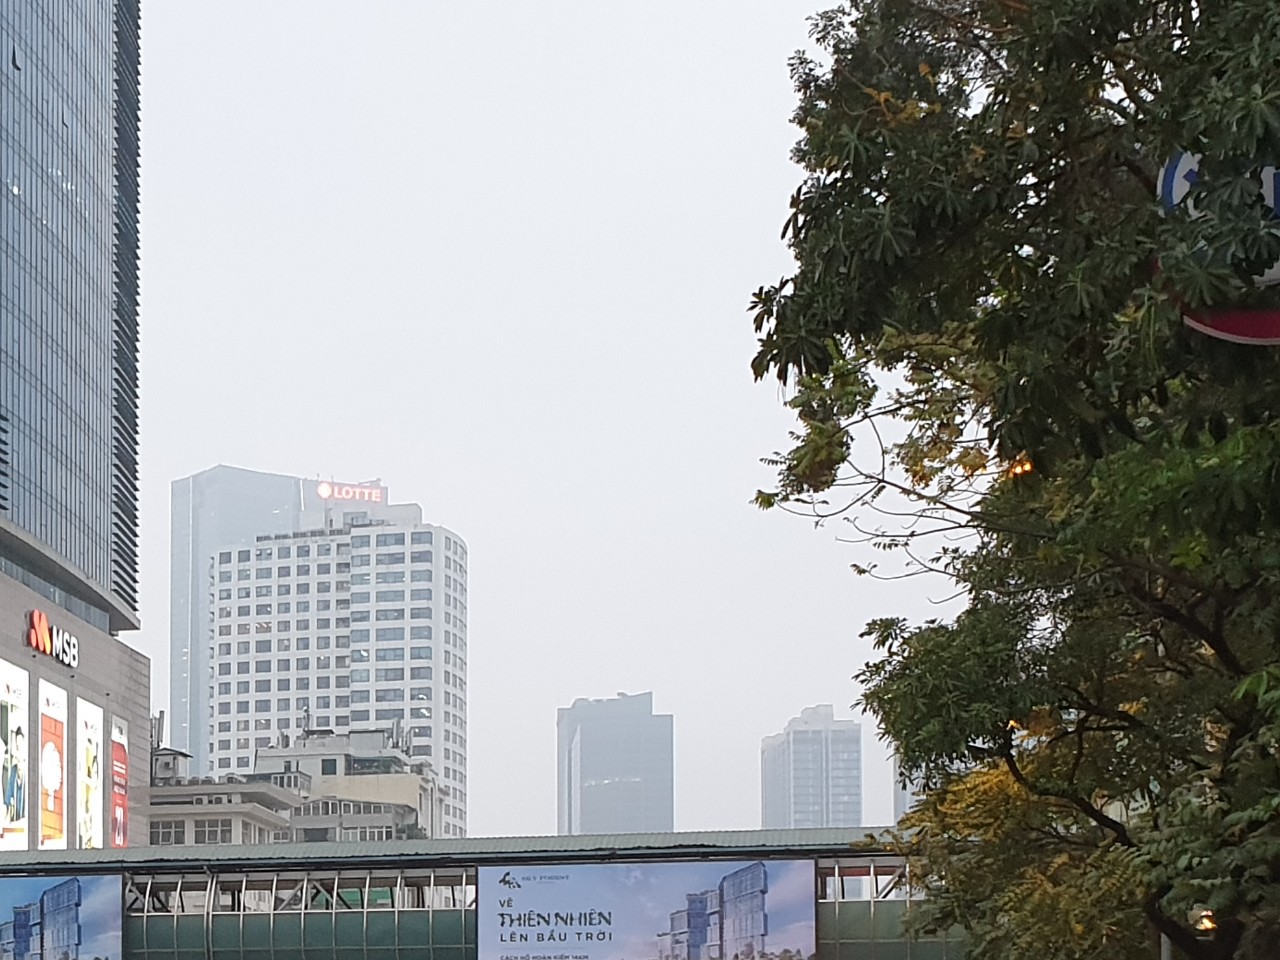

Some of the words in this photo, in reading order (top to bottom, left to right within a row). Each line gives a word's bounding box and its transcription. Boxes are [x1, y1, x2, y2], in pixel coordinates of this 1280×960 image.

[333, 486, 381, 501] LOTTE
[52, 625, 79, 668] MSB
[497, 910, 551, 927] THIÊN
[554, 908, 612, 926] NHIÊN
[500, 931, 528, 942] LÊN
